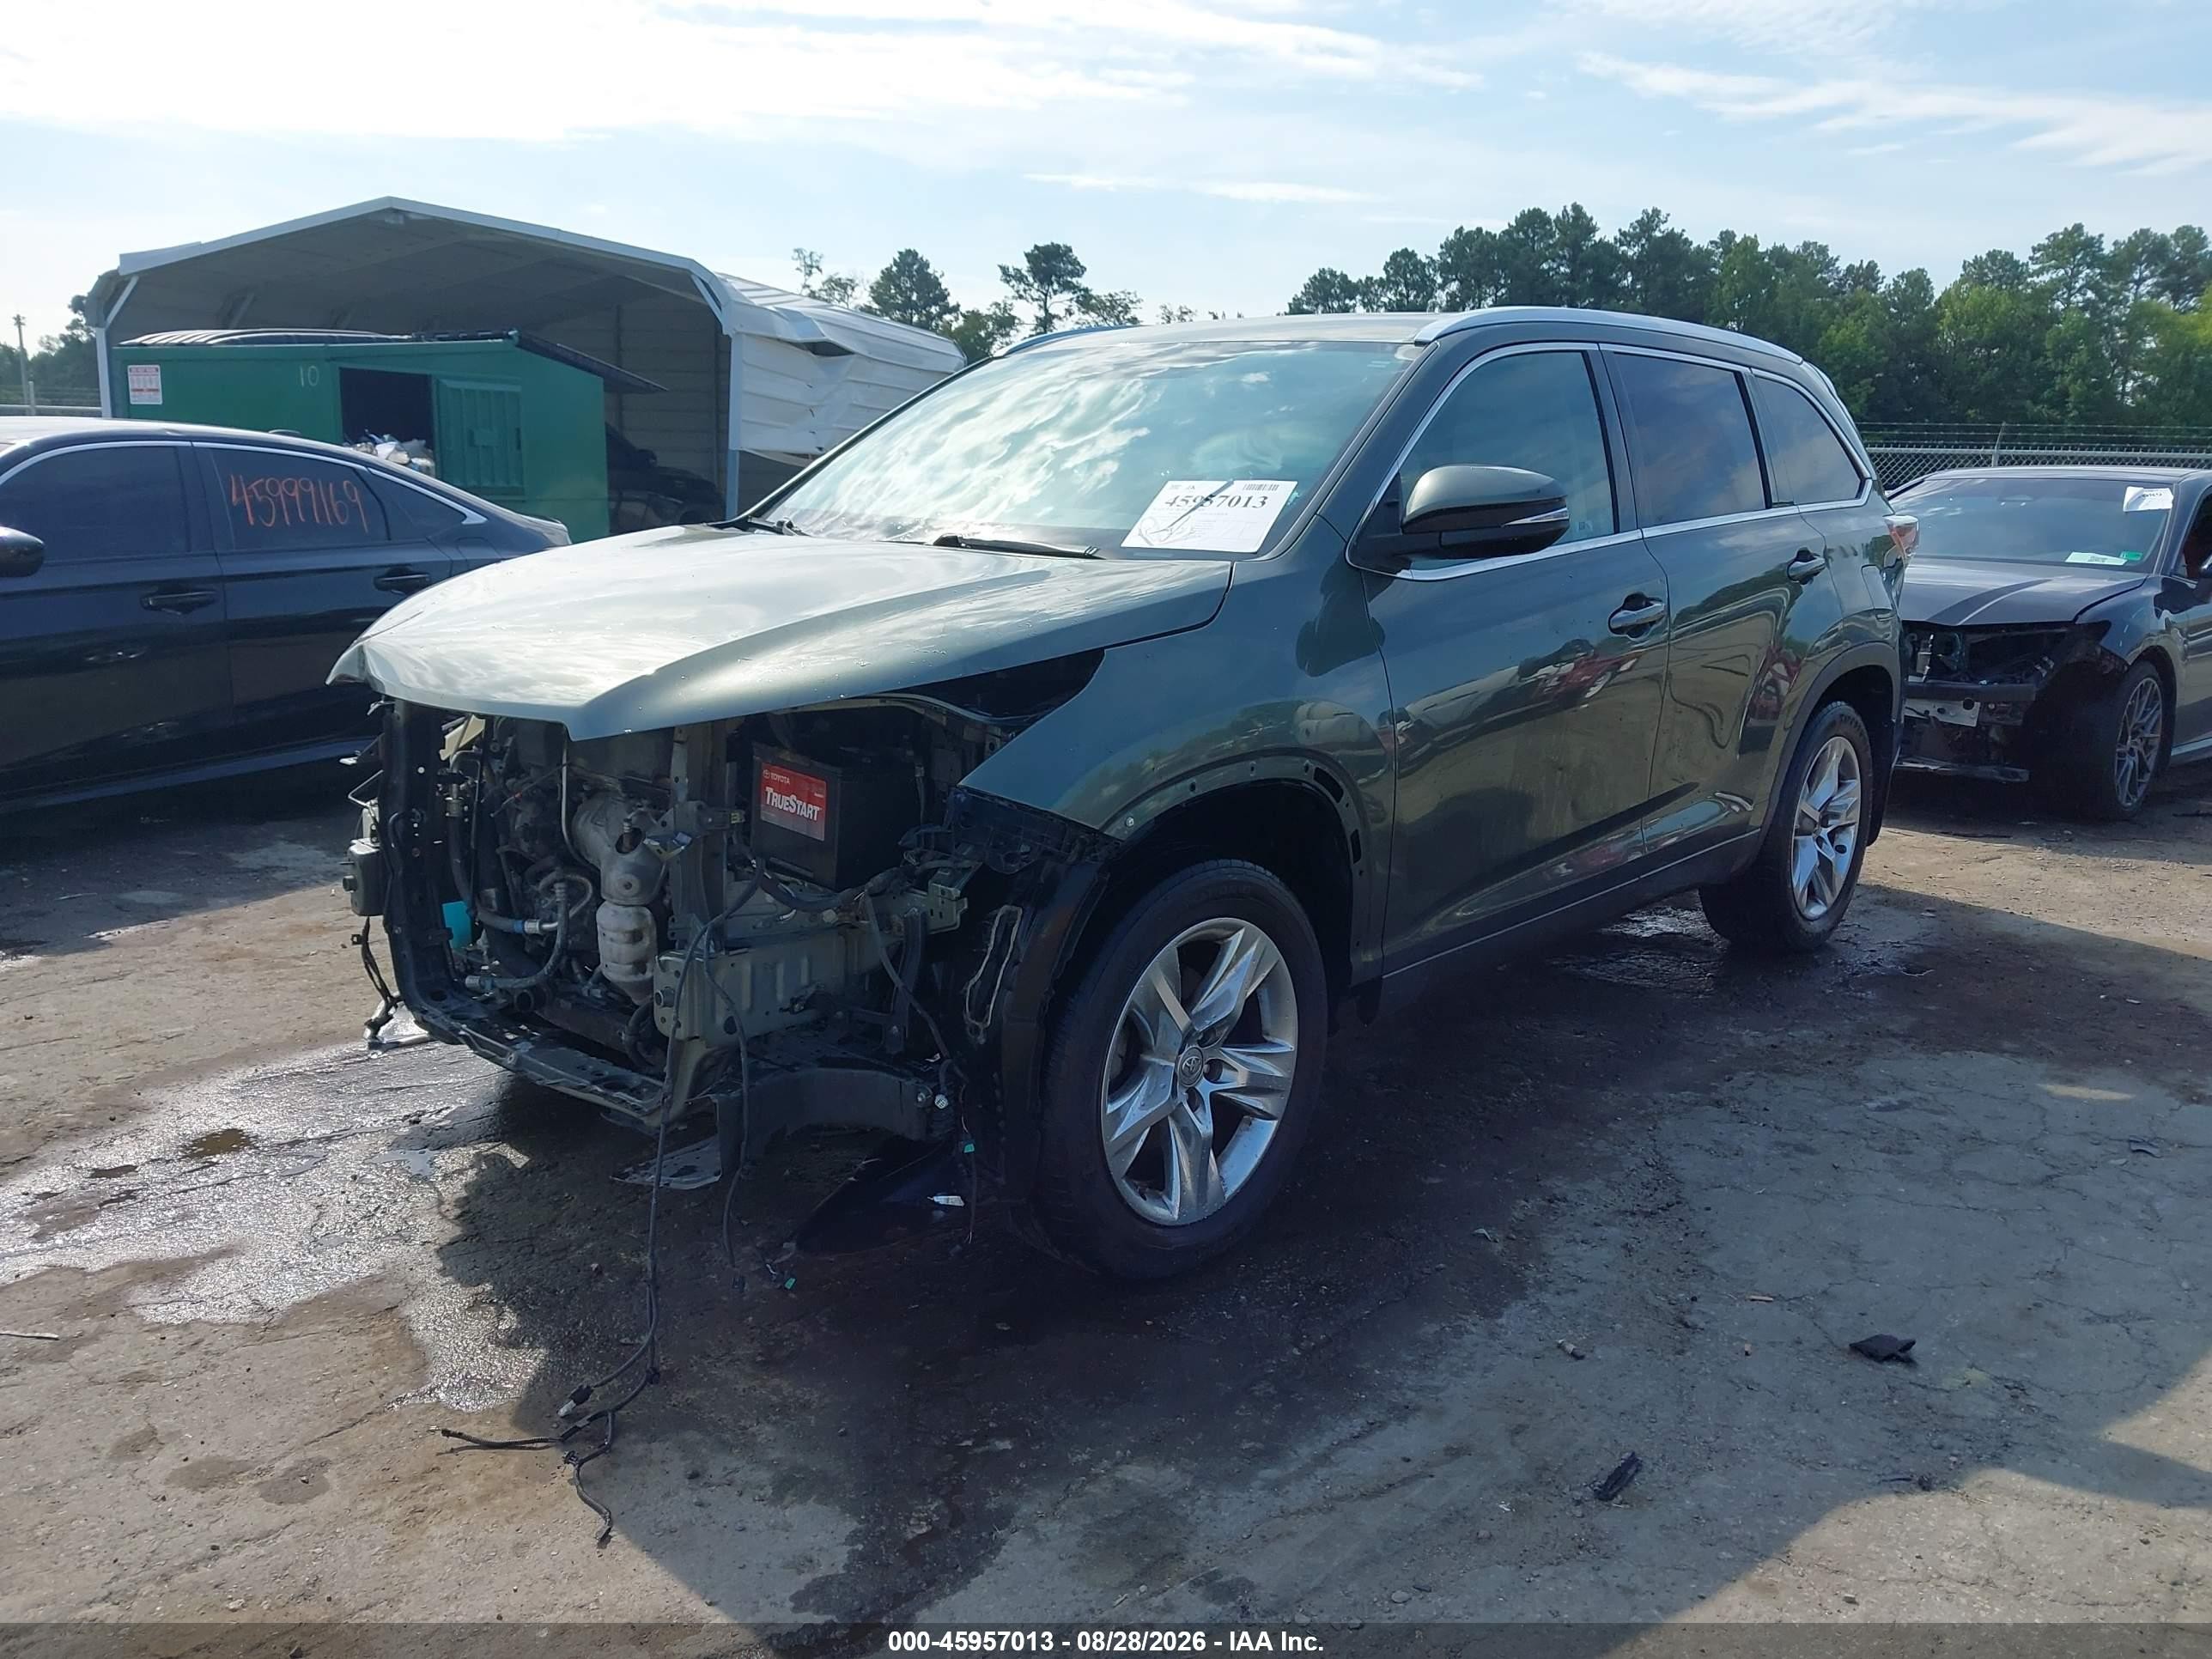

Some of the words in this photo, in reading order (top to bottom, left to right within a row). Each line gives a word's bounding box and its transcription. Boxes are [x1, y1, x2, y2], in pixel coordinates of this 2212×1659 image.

[299, 364, 319, 386] 10
[230, 473, 368, 533] 45999169
[770, 773, 791, 785] TOYOTA
